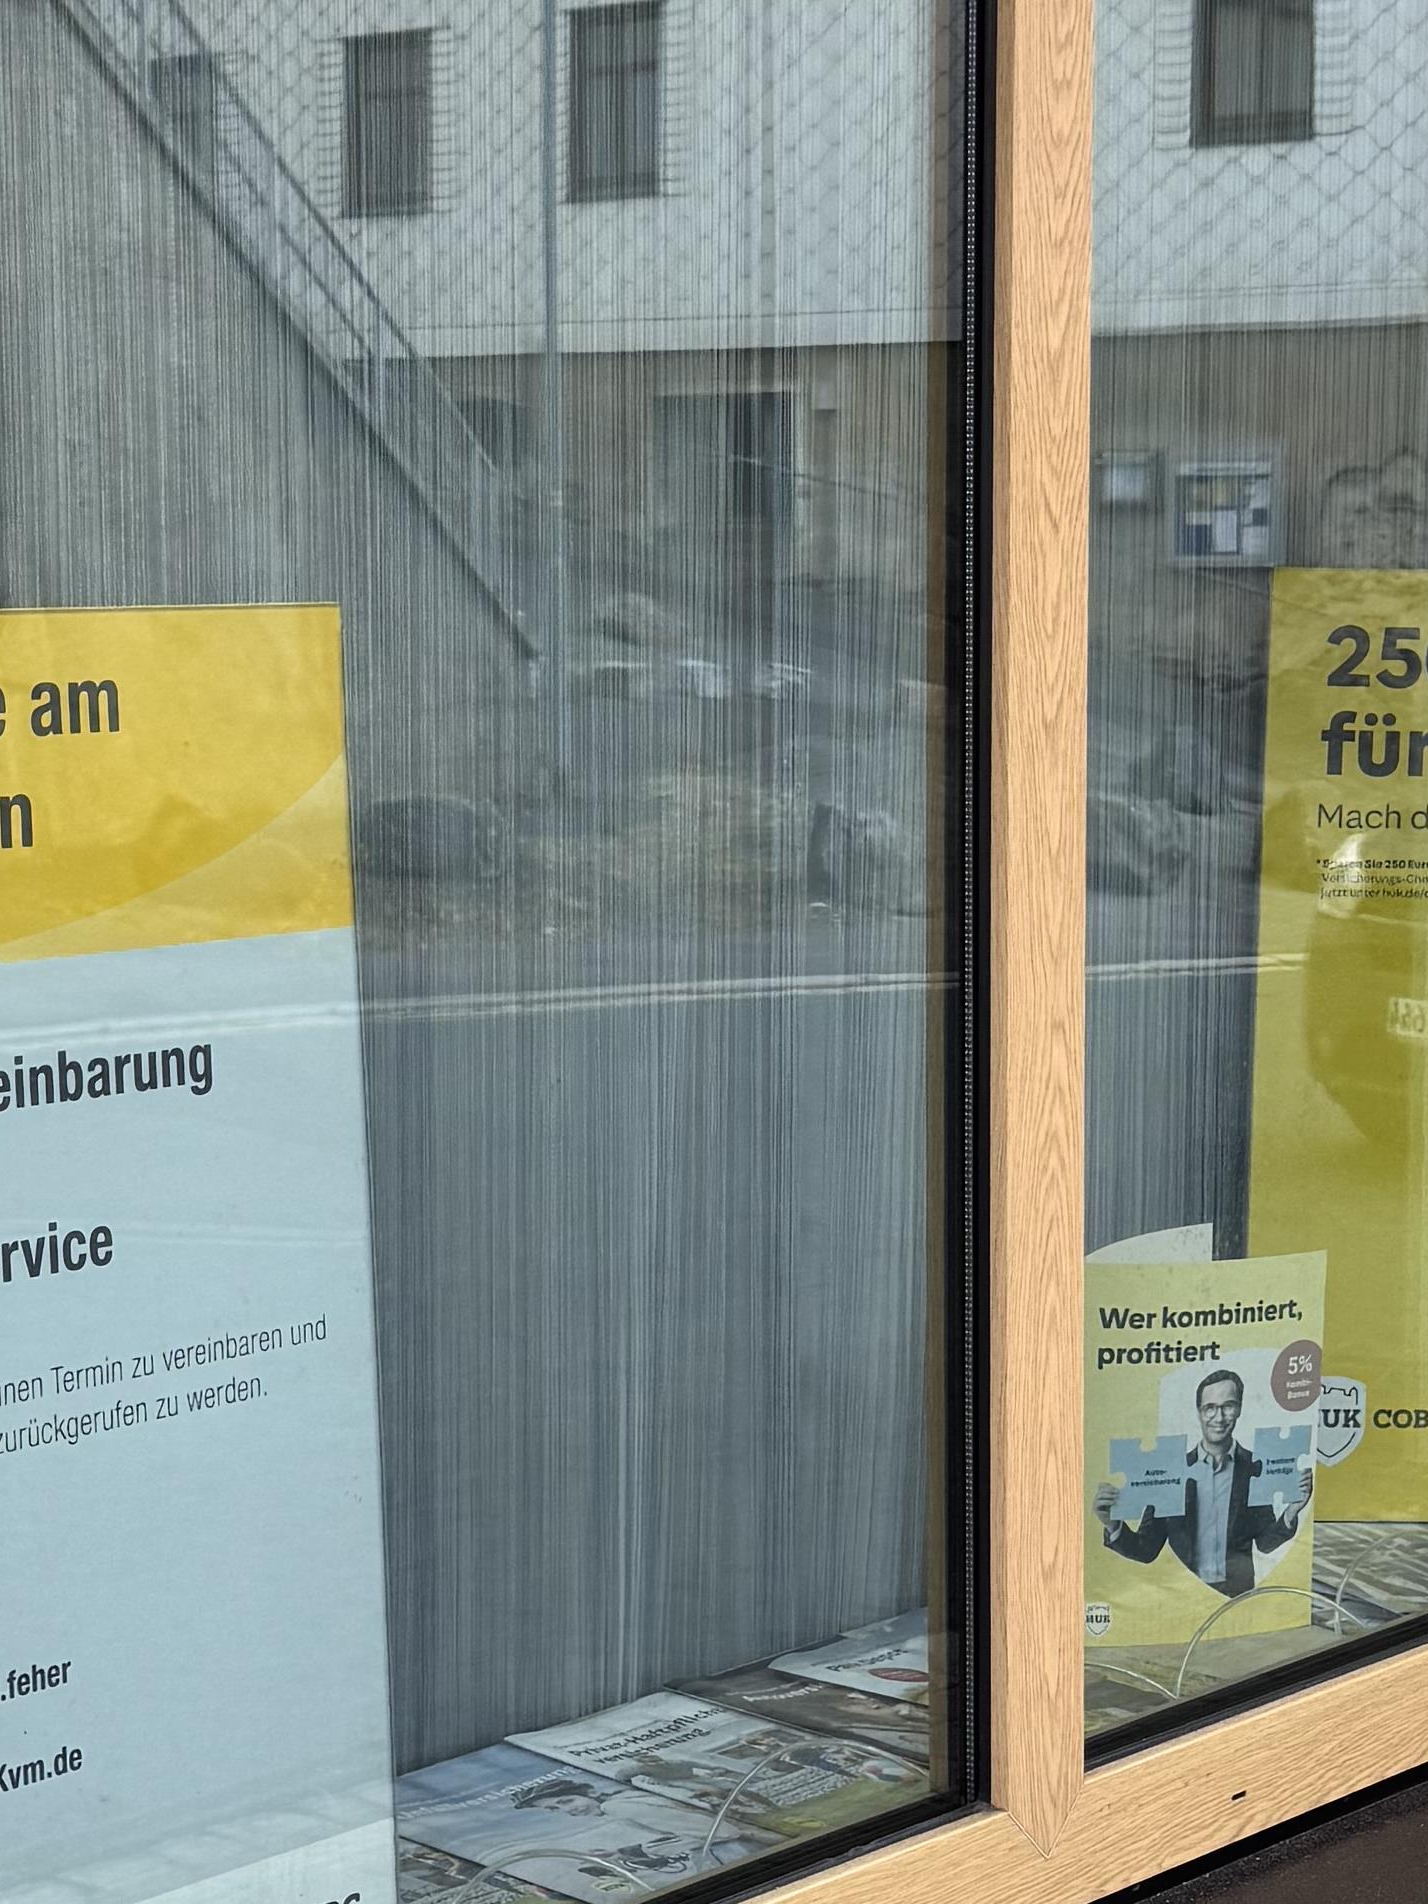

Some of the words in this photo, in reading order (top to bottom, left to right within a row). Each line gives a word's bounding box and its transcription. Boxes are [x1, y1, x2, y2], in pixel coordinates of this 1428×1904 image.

[30, 677, 122, 739] am
[1317, 803, 1402, 830] Mach
[1385, 859, 1406, 869] 250
[1099, 1307, 1156, 1329] Wer
[1162, 1299, 1303, 1329] kombiniert,
[50, 1356, 123, 1395] Termin
[131, 1353, 155, 1380] zu
[162, 1327, 283, 1372] vereinbaren
[290, 1312, 328, 1346] und
[1098, 1340, 1221, 1370] profitiert
[1288, 1354, 1313, 1375] 5%
[155, 1392, 179, 1420] zu
[187, 1375, 269, 1414] werden.
[1318, 1408, 1361, 1428] UK
